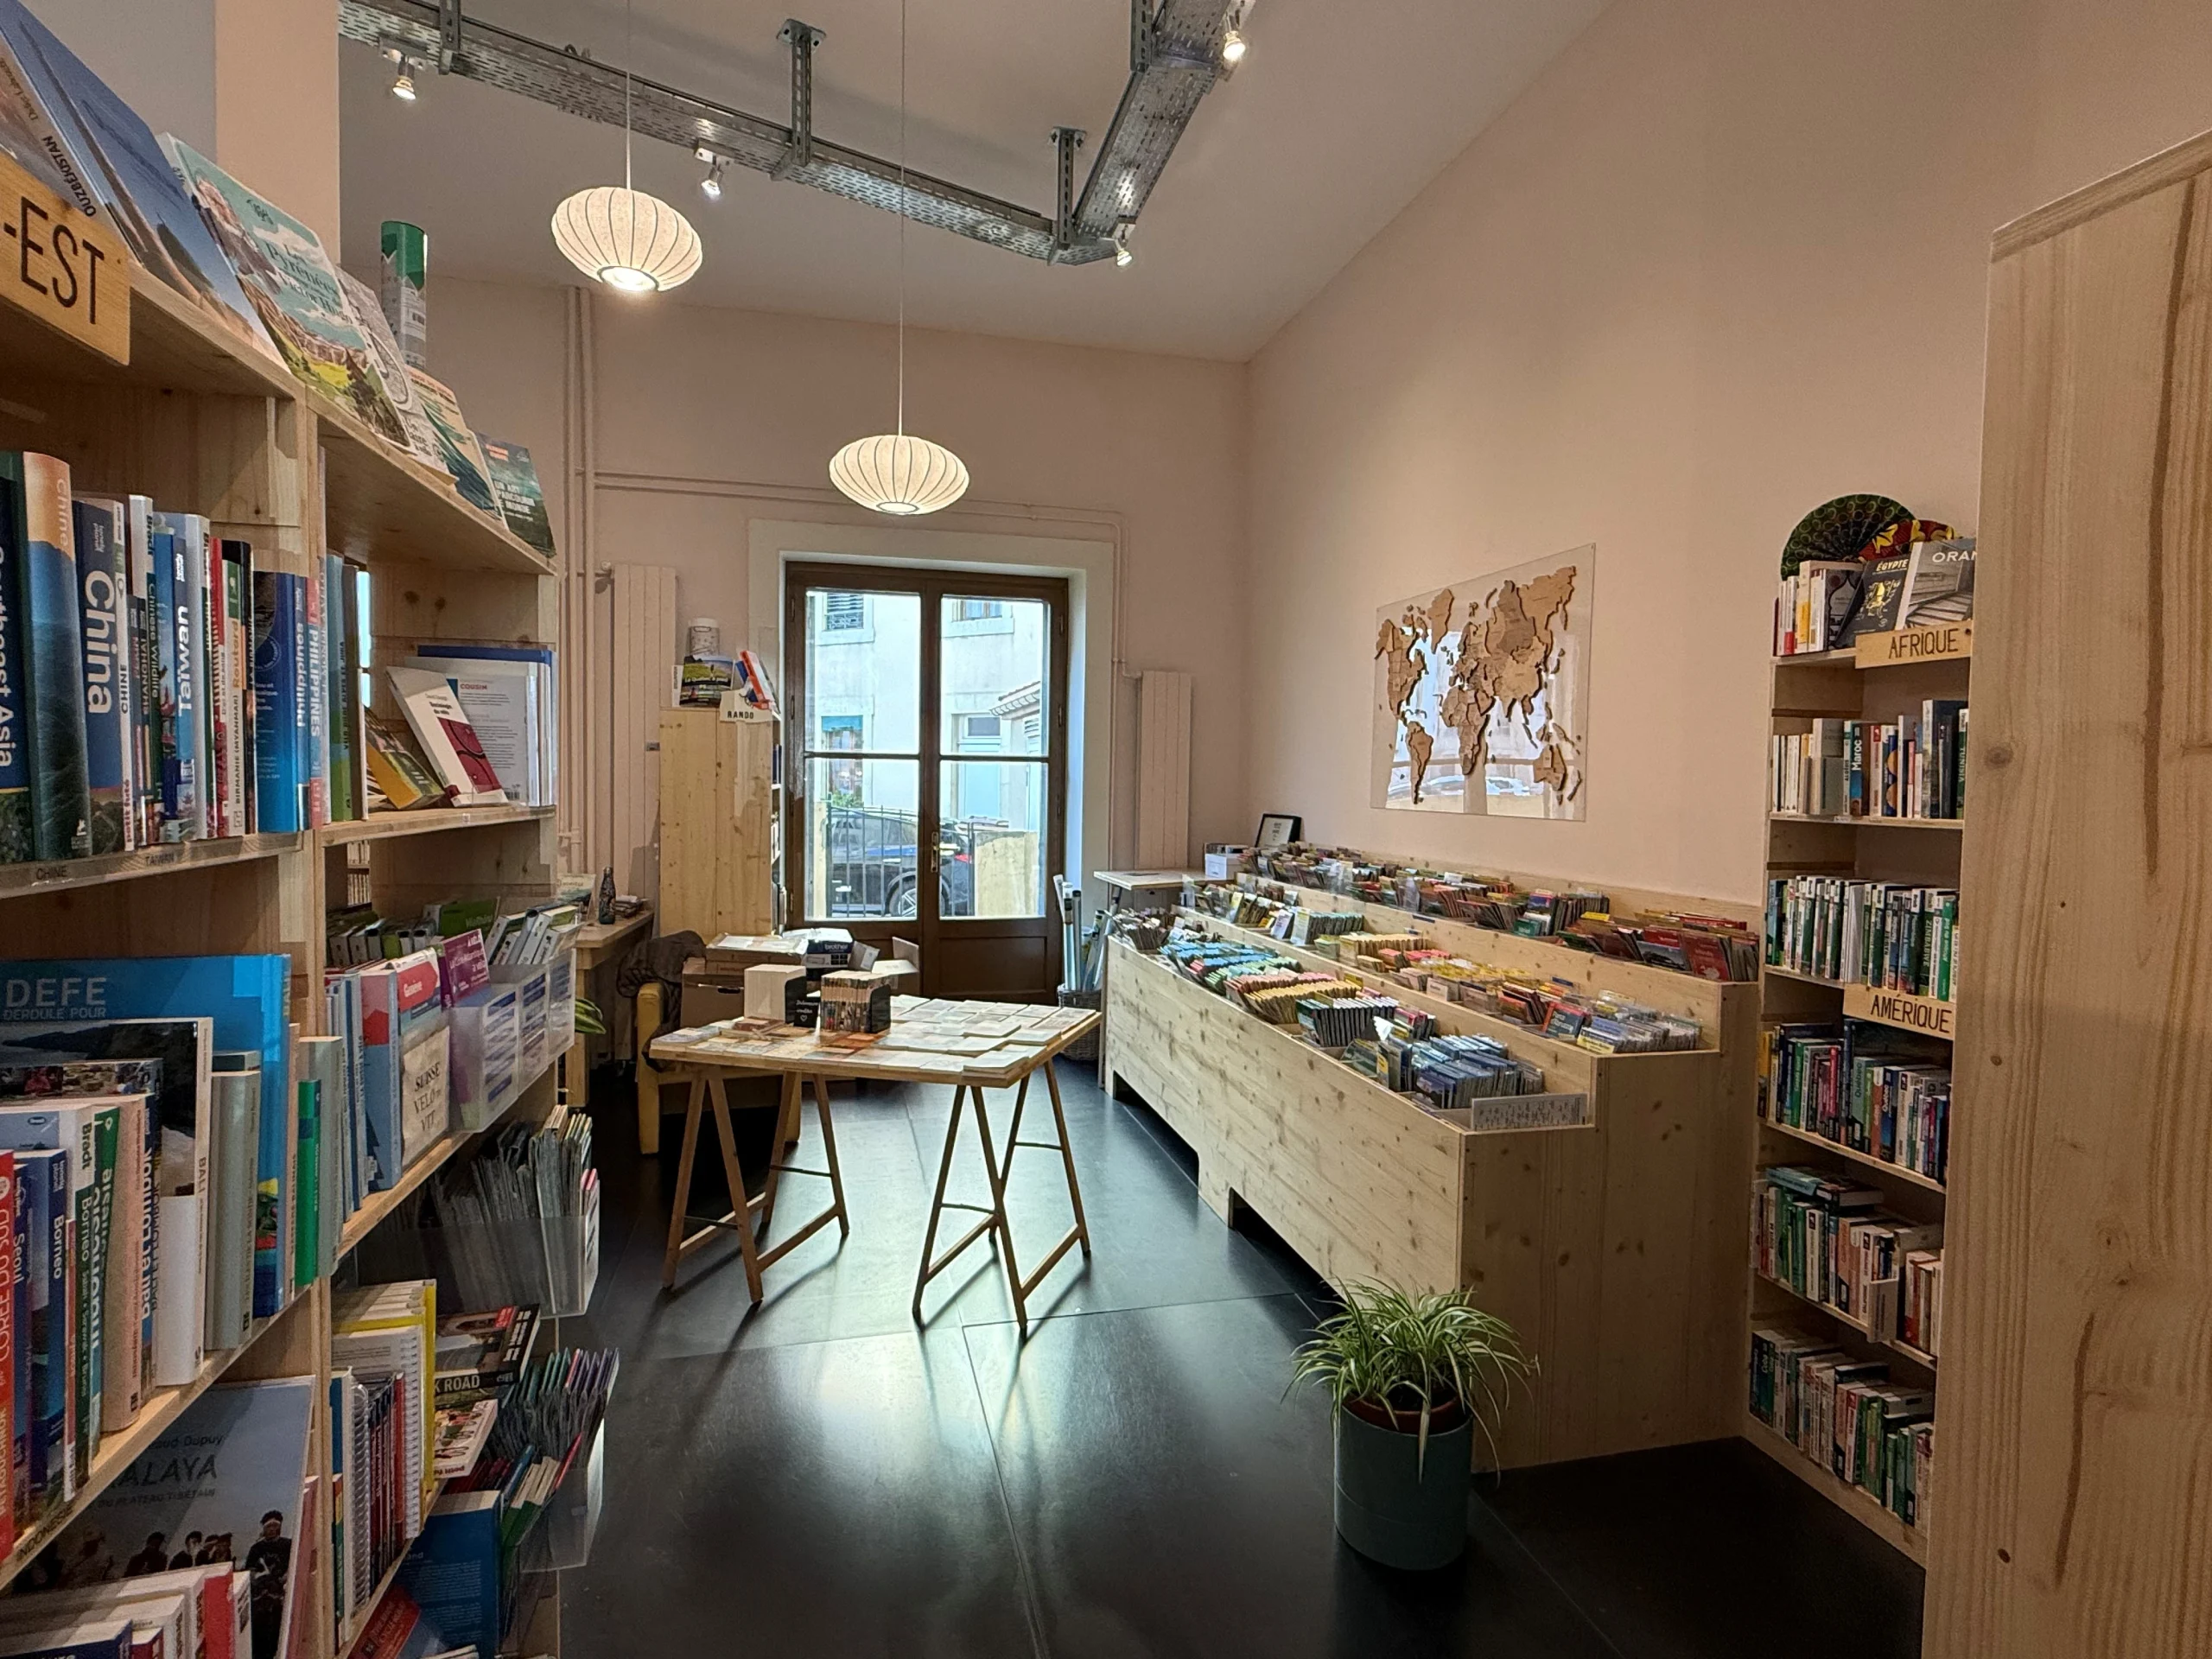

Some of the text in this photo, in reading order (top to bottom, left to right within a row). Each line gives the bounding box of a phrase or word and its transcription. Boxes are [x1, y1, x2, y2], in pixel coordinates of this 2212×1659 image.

[43, 136, 97, 217] OUZBÉKISTAN
[56, 479, 69, 547] Chine
[1876, 558, 1909, 572] ÉGYPTE
[86, 570, 118, 713] China
[1889, 628, 1960, 659] AFRIQUE
[120, 664, 129, 715] CHINE
[309, 629, 321, 737] PHILIPPINES
[0, 705, 15, 767] Asia
[727, 710, 754, 719] RANDO
[1851, 740, 1862, 771] Maroc
[1923, 920, 1932, 967] ZIMBABWE
[1871, 994, 1953, 1033] AMÉRIQUE
[82, 1122, 92, 1169] Bradt
[198, 1157, 207, 1193] BALI
[53, 1215, 65, 1279] Borneo
[81, 1198, 92, 1262] Borneo
[14, 1233, 25, 1285] Seoul
[444, 1376, 480, 1393] ROAD
